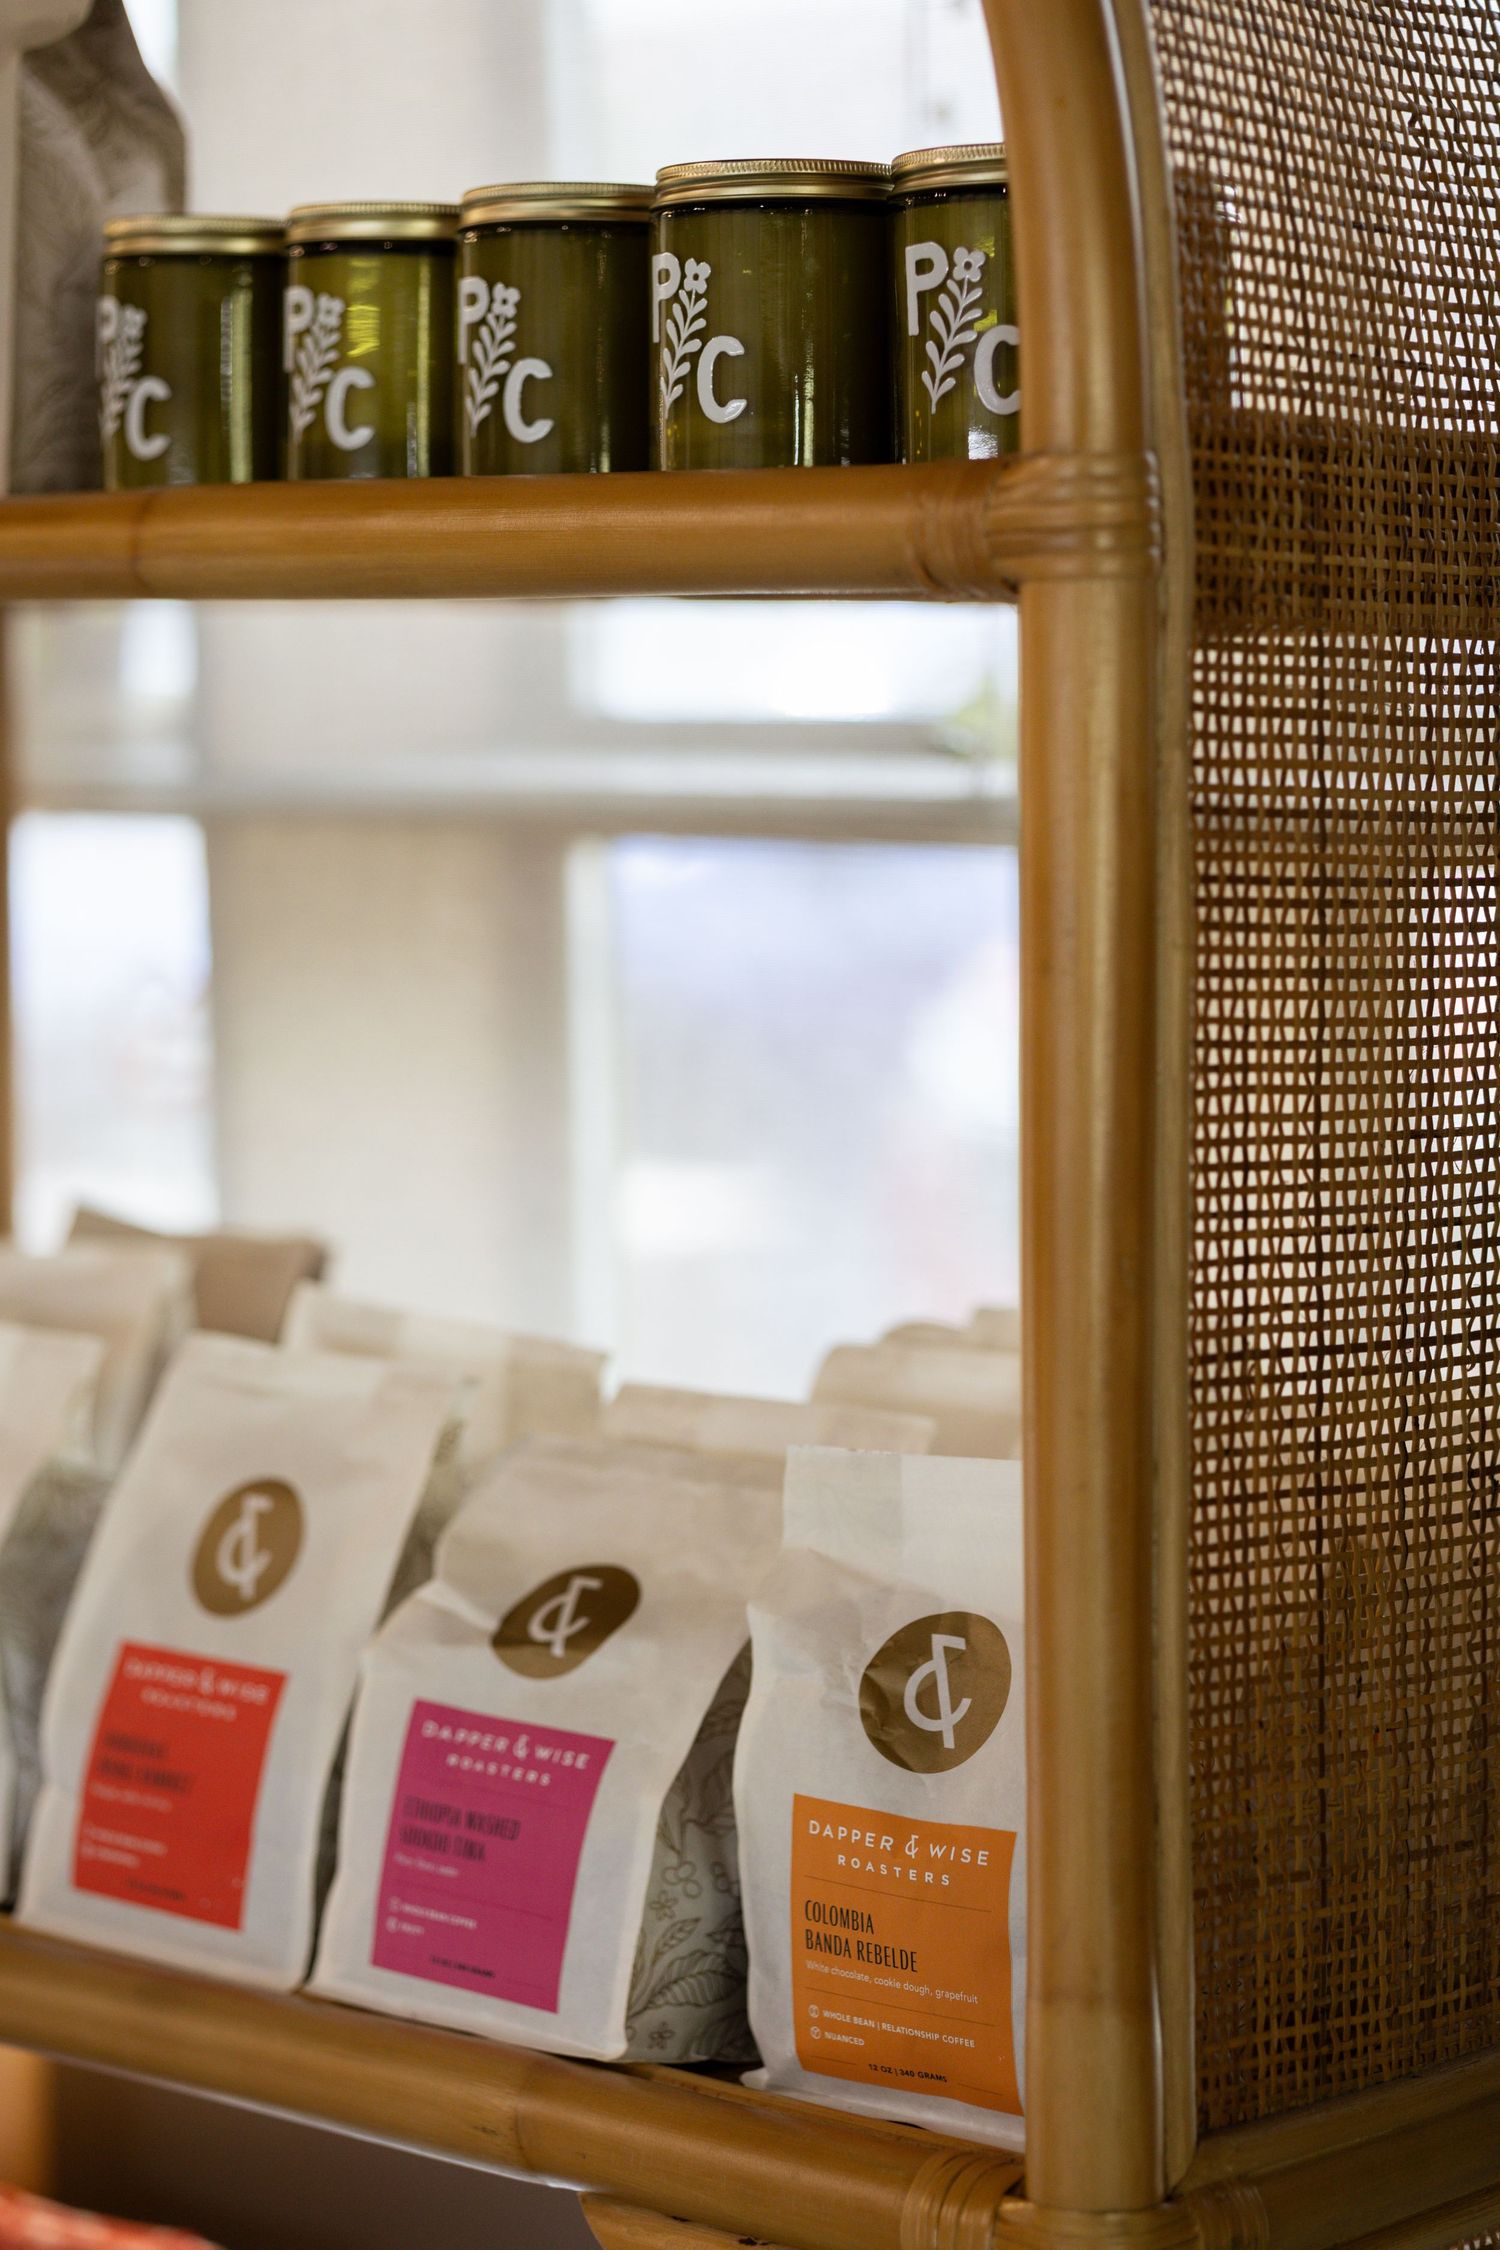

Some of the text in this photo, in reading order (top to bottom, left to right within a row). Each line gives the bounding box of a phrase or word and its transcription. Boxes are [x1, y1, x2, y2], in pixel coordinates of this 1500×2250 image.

[652, 252, 682, 343] P
[905, 241, 949, 336] P
[283, 285, 315, 373] P
[458, 276, 489, 364] P
[697, 335, 747, 424] C
[973, 324, 1022, 415] C
[124, 376, 171, 461] C
[325, 366, 375, 451] C
[503, 357, 554, 443] C
[421, 1719, 591, 1770] DAPPER & WISE
[446, 1753, 551, 1786] ROASTERS
[808, 1820, 990, 1866] DAPPER & WISE
[838, 1855, 950, 1886] ROASTERS
[804, 1900, 874, 1934] COLOMBIA
[805, 1929, 918, 1972] BANDA REBELDE
[830, 1966, 872, 1984] chocolate,
[874, 1975, 901, 1989] cookie
[903, 1981, 933, 1996] dough,
[935, 1988, 978, 2004] grapefruit
[823, 2010, 851, 2023] WHOLE
[852, 2016, 875, 2028] BEAN
[882, 2022, 940, 2041] RELATIONSHIP
[942, 2034, 976, 2048] COFFEE
[824, 2031, 865, 2046] NUANCED
[868, 2063, 878, 2072] 12
[880, 2066, 893, 2074] OZ
[900, 2069, 915, 2078] 340
[917, 2071, 948, 2083] GRAMS
